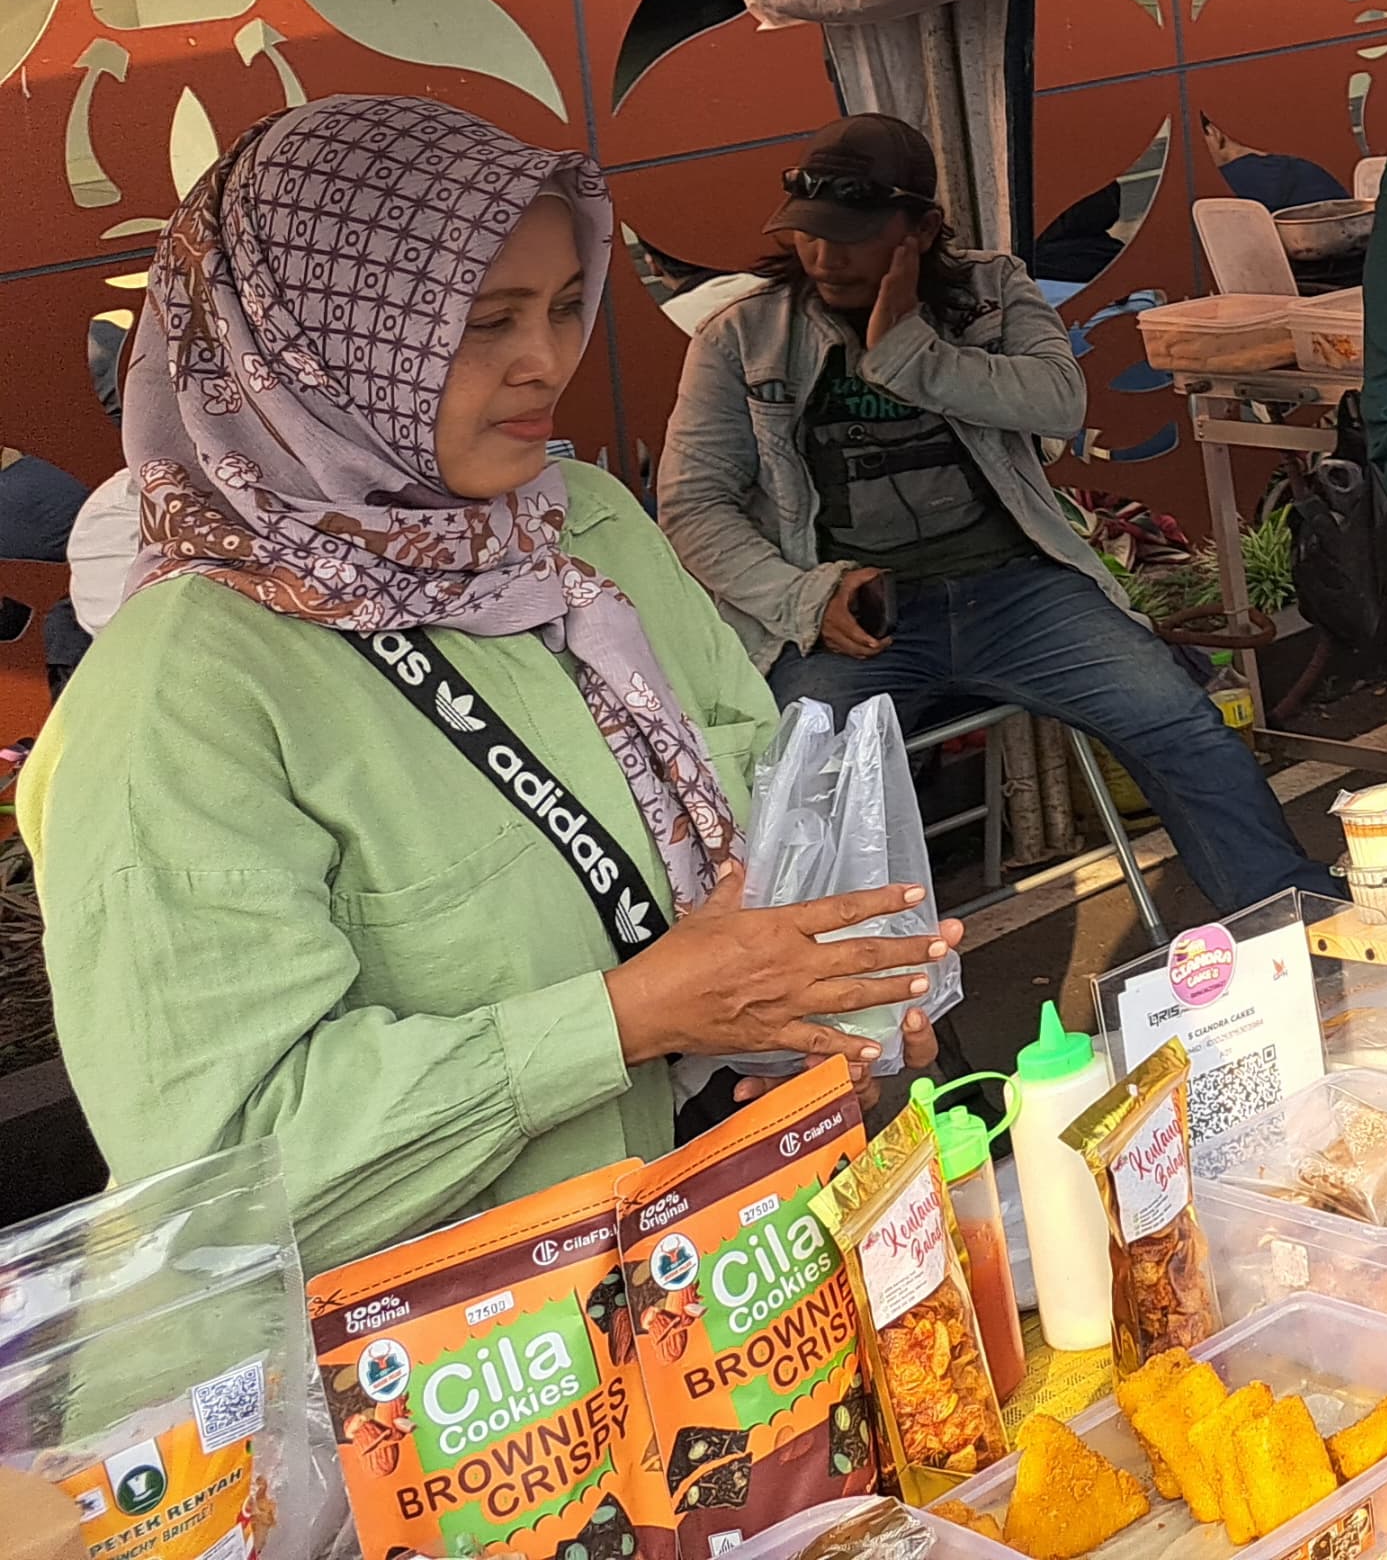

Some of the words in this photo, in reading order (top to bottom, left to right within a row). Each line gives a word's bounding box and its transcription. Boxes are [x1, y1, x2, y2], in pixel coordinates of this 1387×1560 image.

[487, 744, 621, 895] adidas
[1171, 948, 1232, 985] CIANDRA
[802, 1113, 843, 1143] CilaFD.id
[638, 1190, 681, 1222] 100%
[639, 1199, 689, 1232] Original
[711, 1215, 826, 1308] Cila
[728, 1251, 832, 1334] Cookies
[343, 1293, 401, 1323] 100%
[346, 1303, 411, 1335] Original
[423, 1327, 573, 1427] Cila
[439, 1375, 581, 1456] Cookies
[396, 1376, 627, 1521] BROWNIES
[487, 1404, 630, 1519] CRISPY
[87, 1516, 163, 1560] PEYEK
[166, 1466, 244, 1521] RENYAH
[161, 1502, 215, 1543] BRITTLE!
